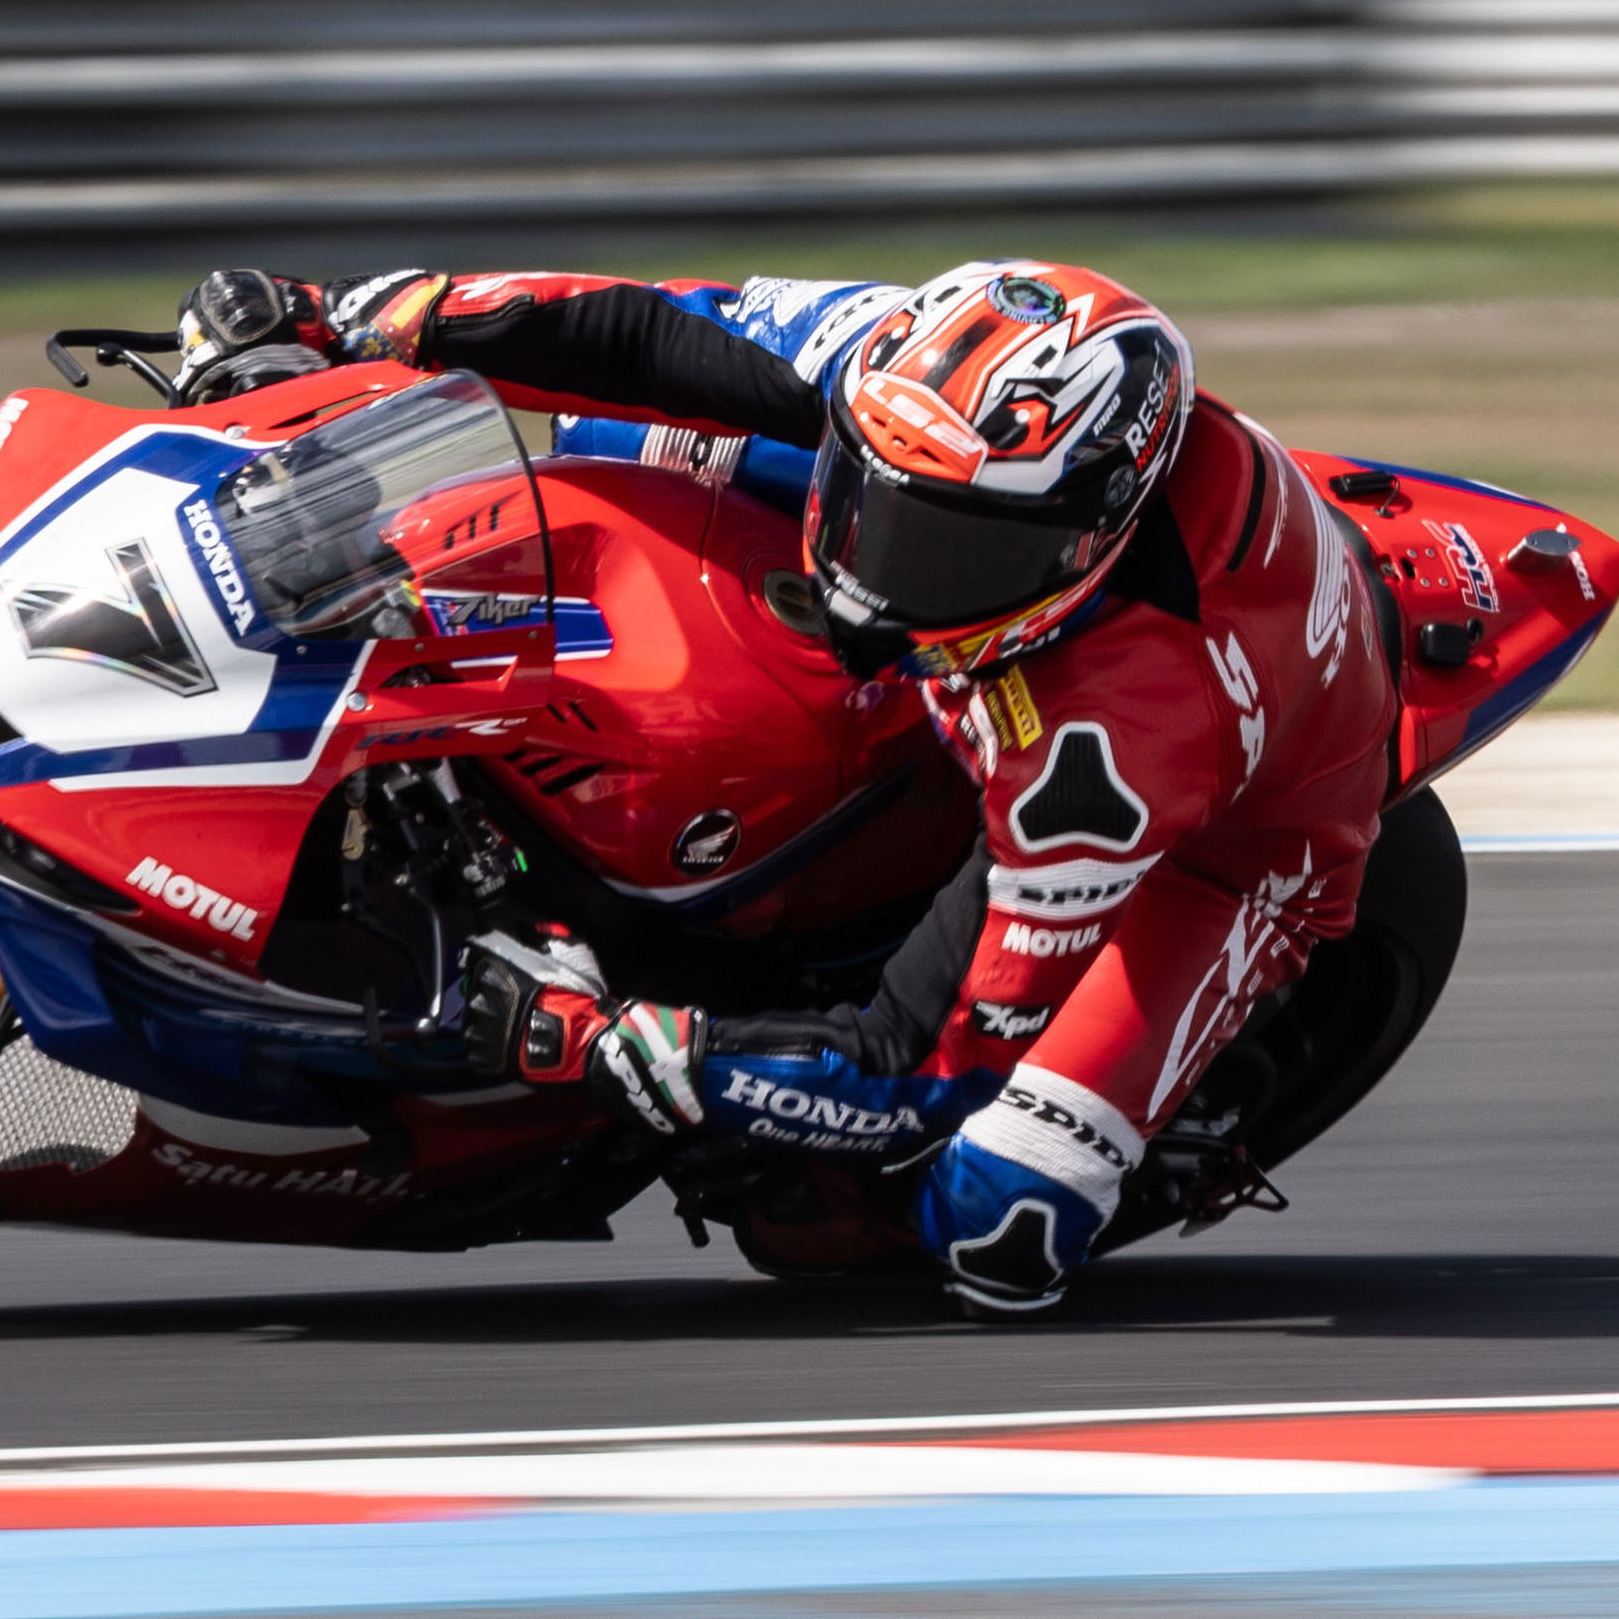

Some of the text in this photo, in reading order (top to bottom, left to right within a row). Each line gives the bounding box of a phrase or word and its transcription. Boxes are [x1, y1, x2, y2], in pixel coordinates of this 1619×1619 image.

[183, 499, 256, 637] HONDA
[7, 538, 219, 698] 7
[125, 856, 259, 942] MOTUL
[1001, 921, 1101, 958] MOTUL
[721, 1068, 925, 1134] HONDA
